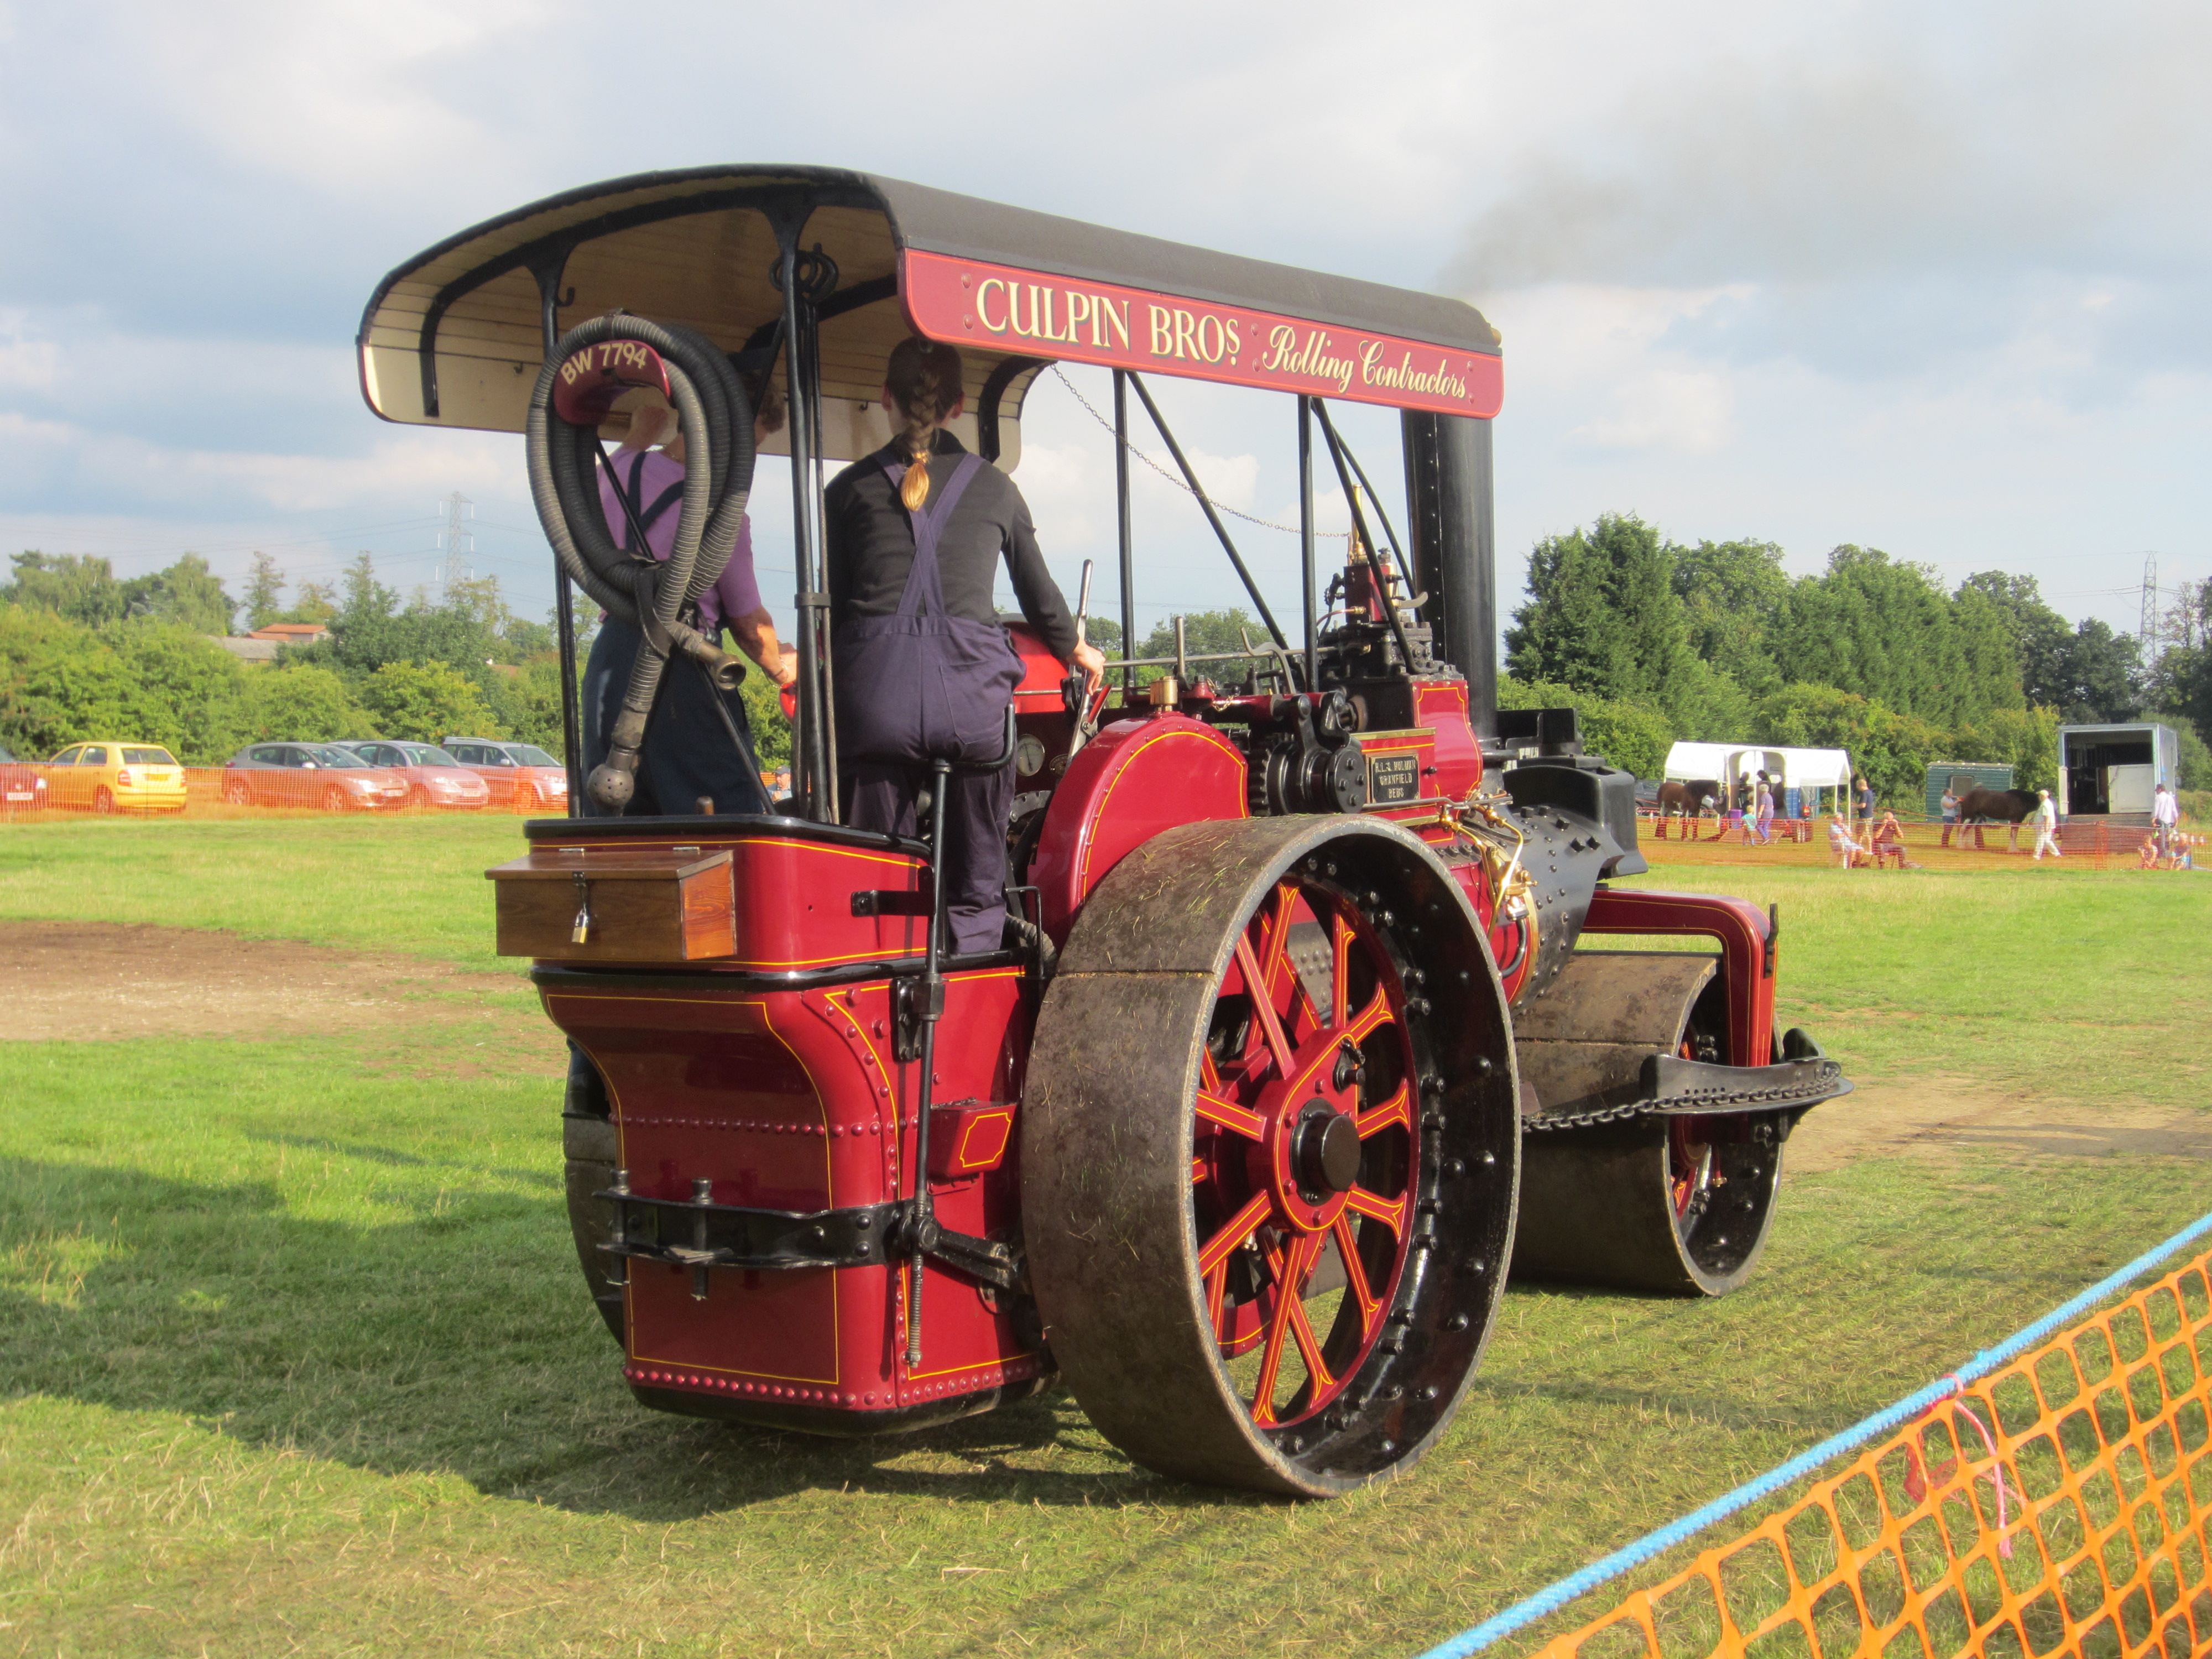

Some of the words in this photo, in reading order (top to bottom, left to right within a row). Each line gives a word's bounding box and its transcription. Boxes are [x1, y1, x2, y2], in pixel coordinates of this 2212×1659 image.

[977, 278, 1130, 350] CULPIN
[561, 348, 592, 385] BW
[598, 342, 647, 369] 7794
[1262, 325, 1354, 393] Rolling
[1358, 340, 1466, 398] Contractors
[1394, 759, 1416, 771] HOLMAN
